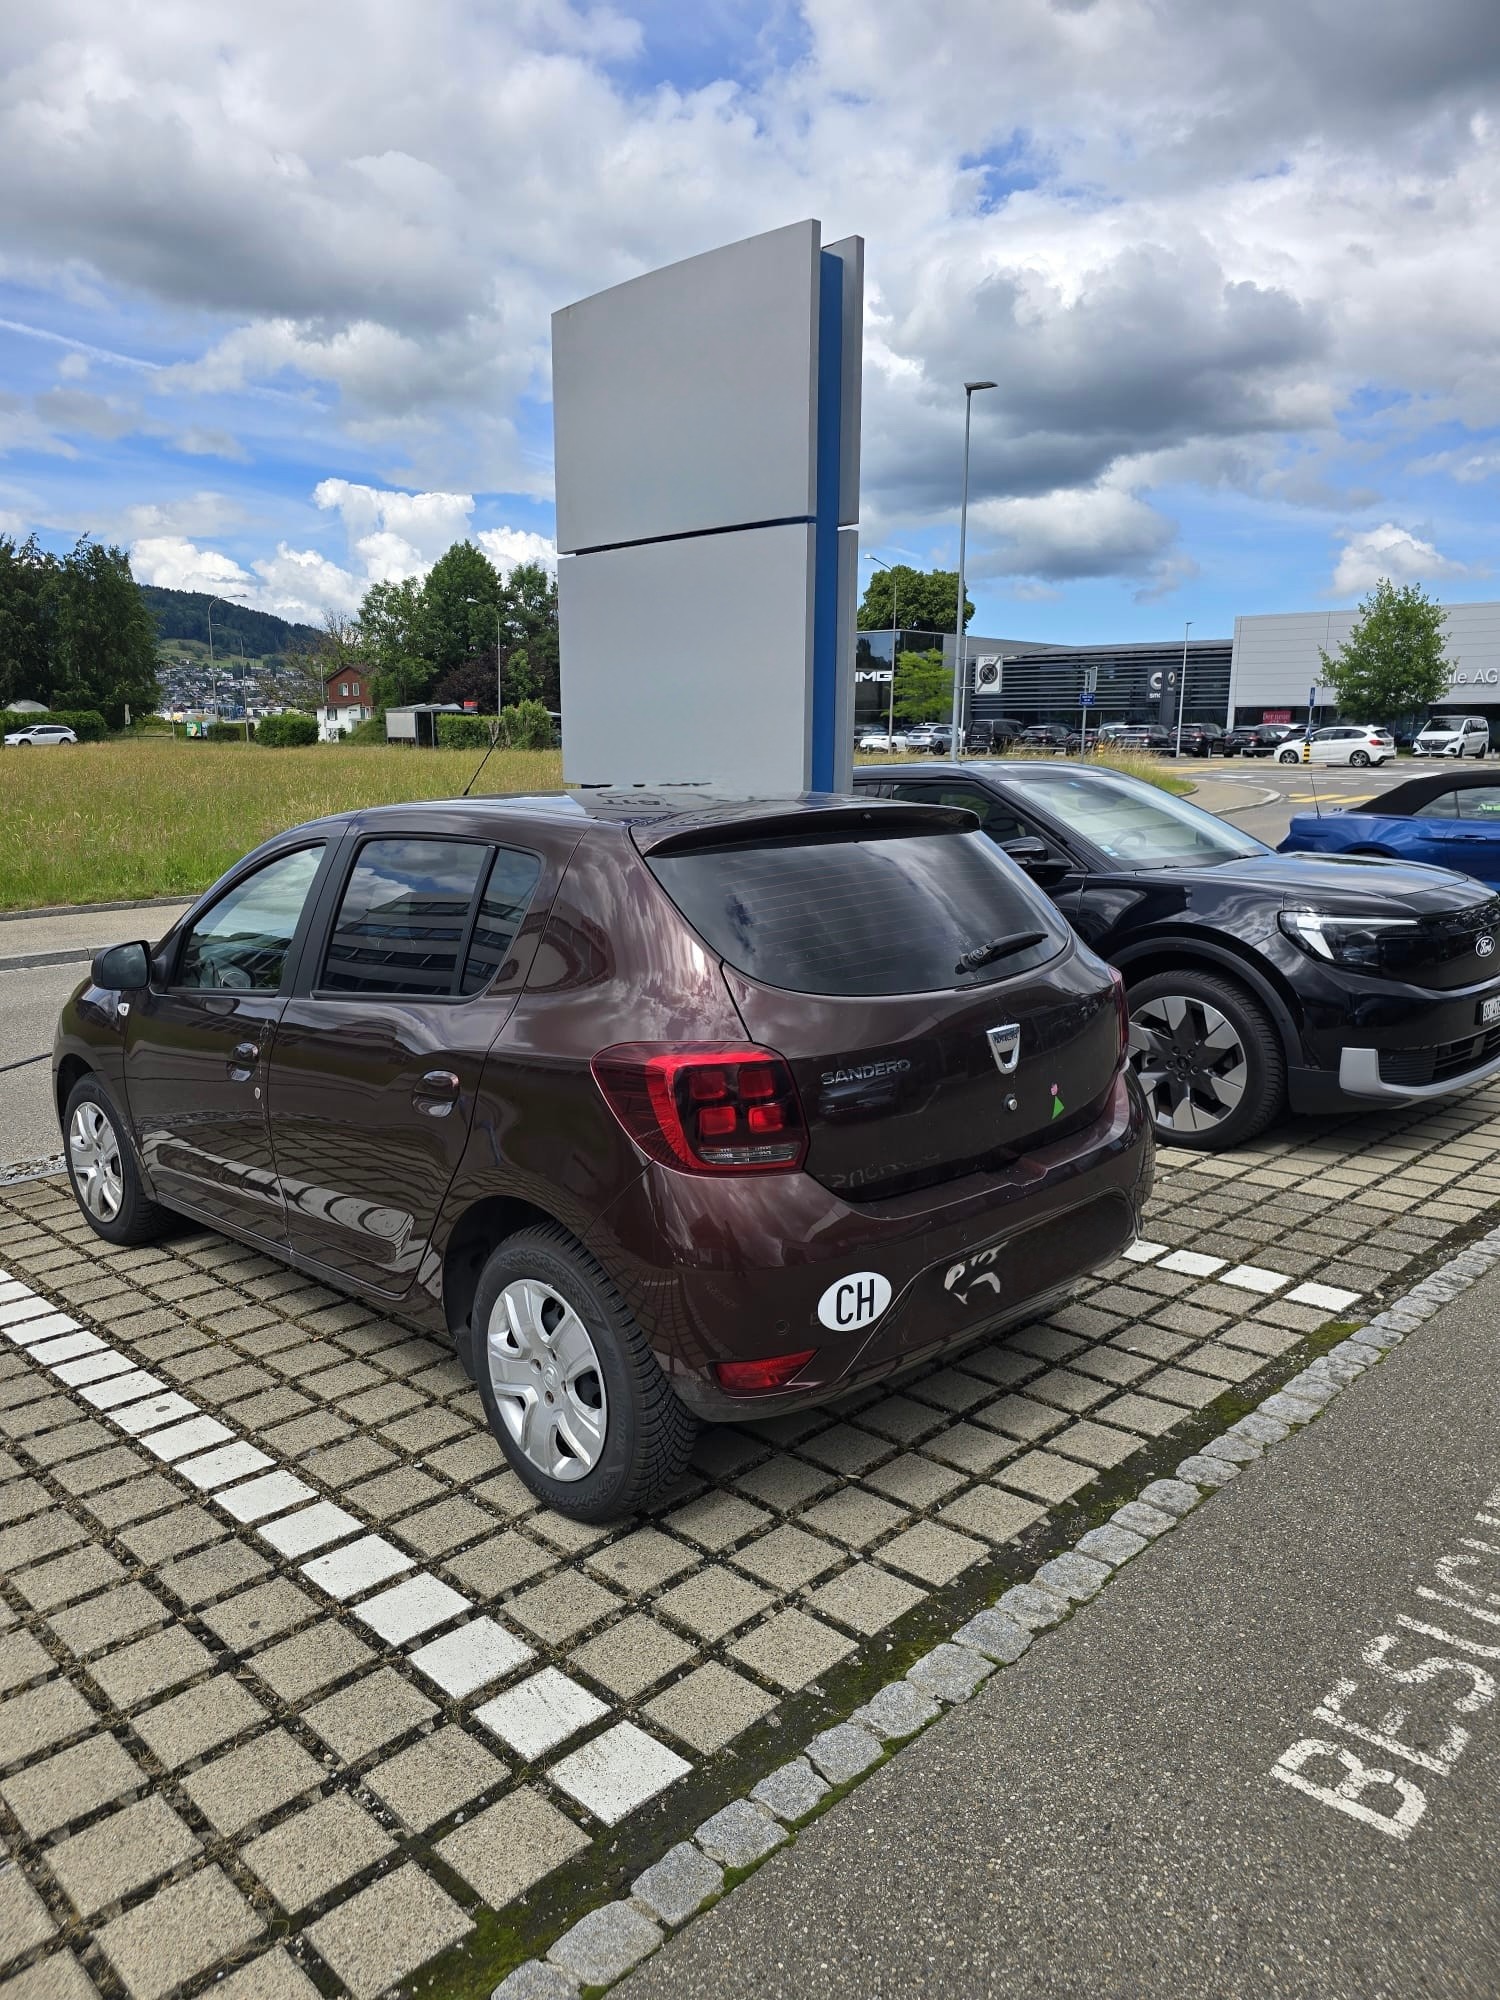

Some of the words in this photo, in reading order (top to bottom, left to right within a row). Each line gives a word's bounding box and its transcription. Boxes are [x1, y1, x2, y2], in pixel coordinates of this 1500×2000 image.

[1473, 667, 1498, 684] AG
[821, 1059, 911, 1085] SANDERO
[836, 1279, 875, 1325] CH
